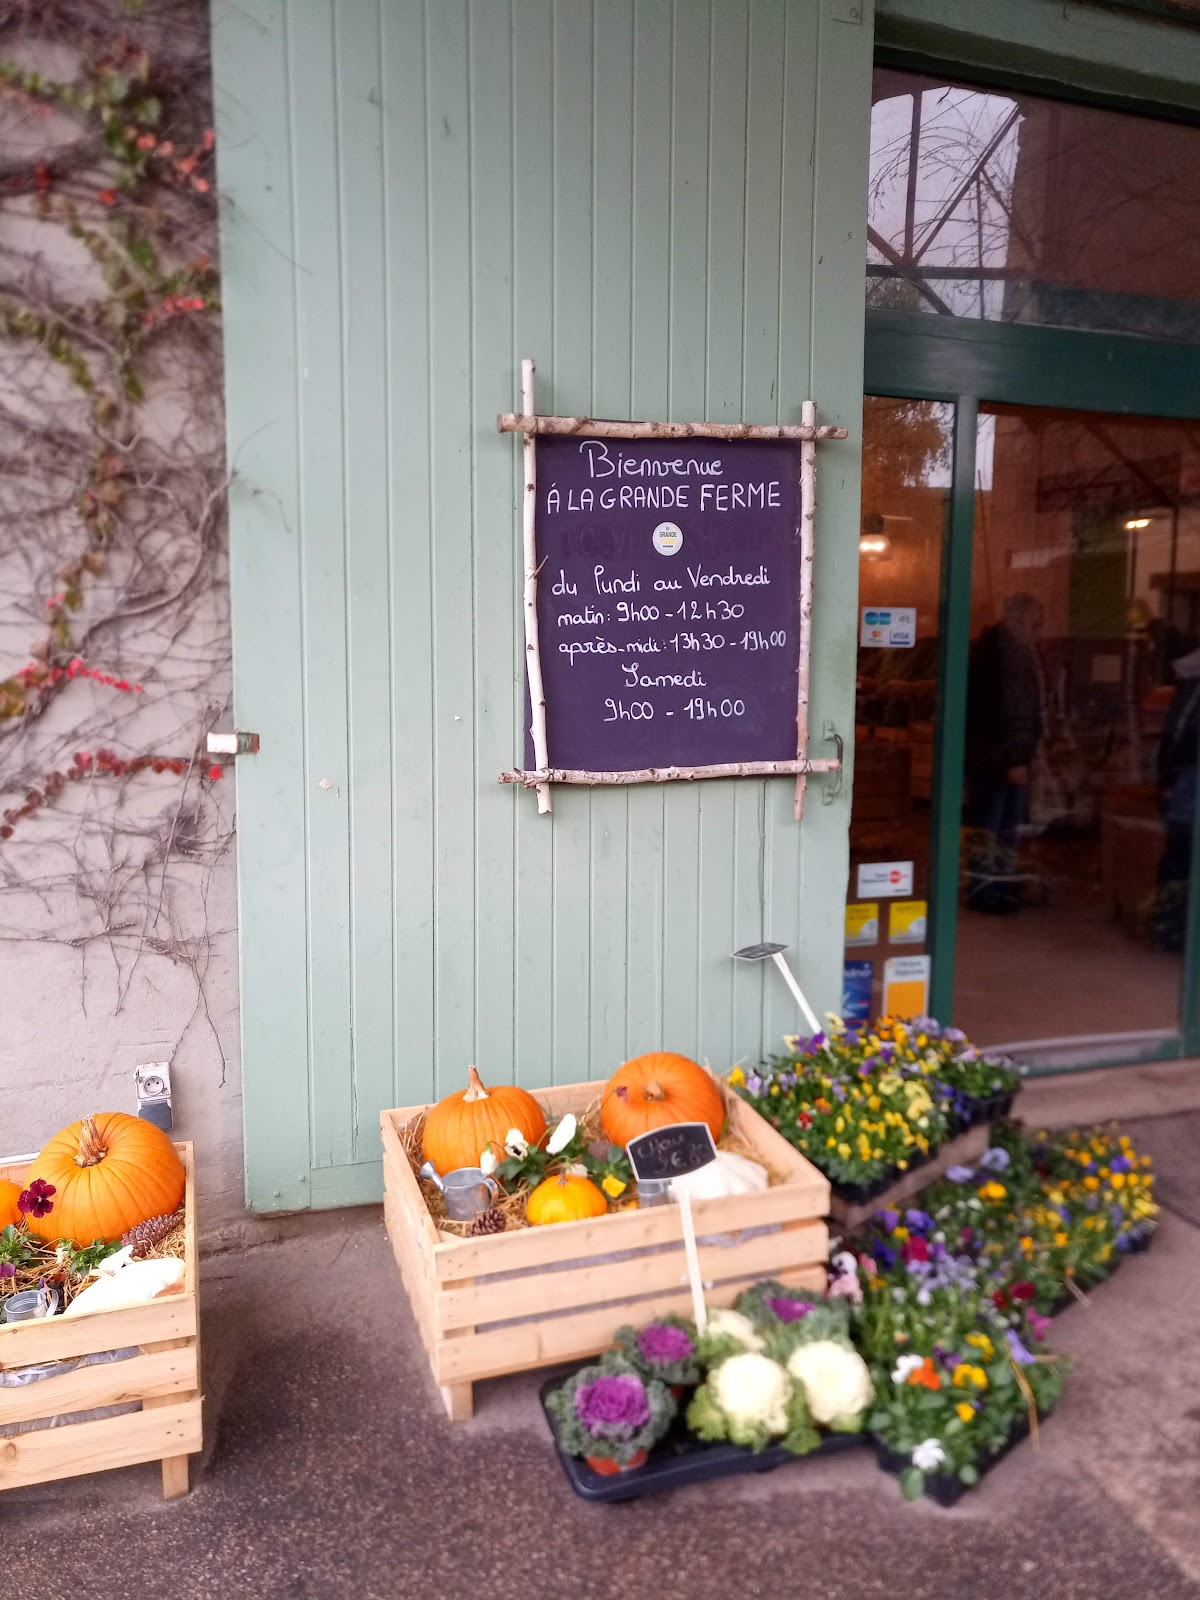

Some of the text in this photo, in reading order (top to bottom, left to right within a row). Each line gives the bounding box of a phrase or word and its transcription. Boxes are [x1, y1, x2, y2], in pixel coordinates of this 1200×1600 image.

[579, 440, 724, 479] Bienvenue
[568, 488, 594, 512] LA
[599, 484, 690, 510] GRANDE
[700, 481, 781, 512] FERME
[551, 569, 578, 596] du
[653, 578, 682, 591] au
[687, 563, 771, 588] Vendredi
[616, 601, 660, 623] 9h00
[740, 630, 787, 651] 19h00
[621, 662, 707, 688] Samedi
[603, 697, 654, 722] 9h00
